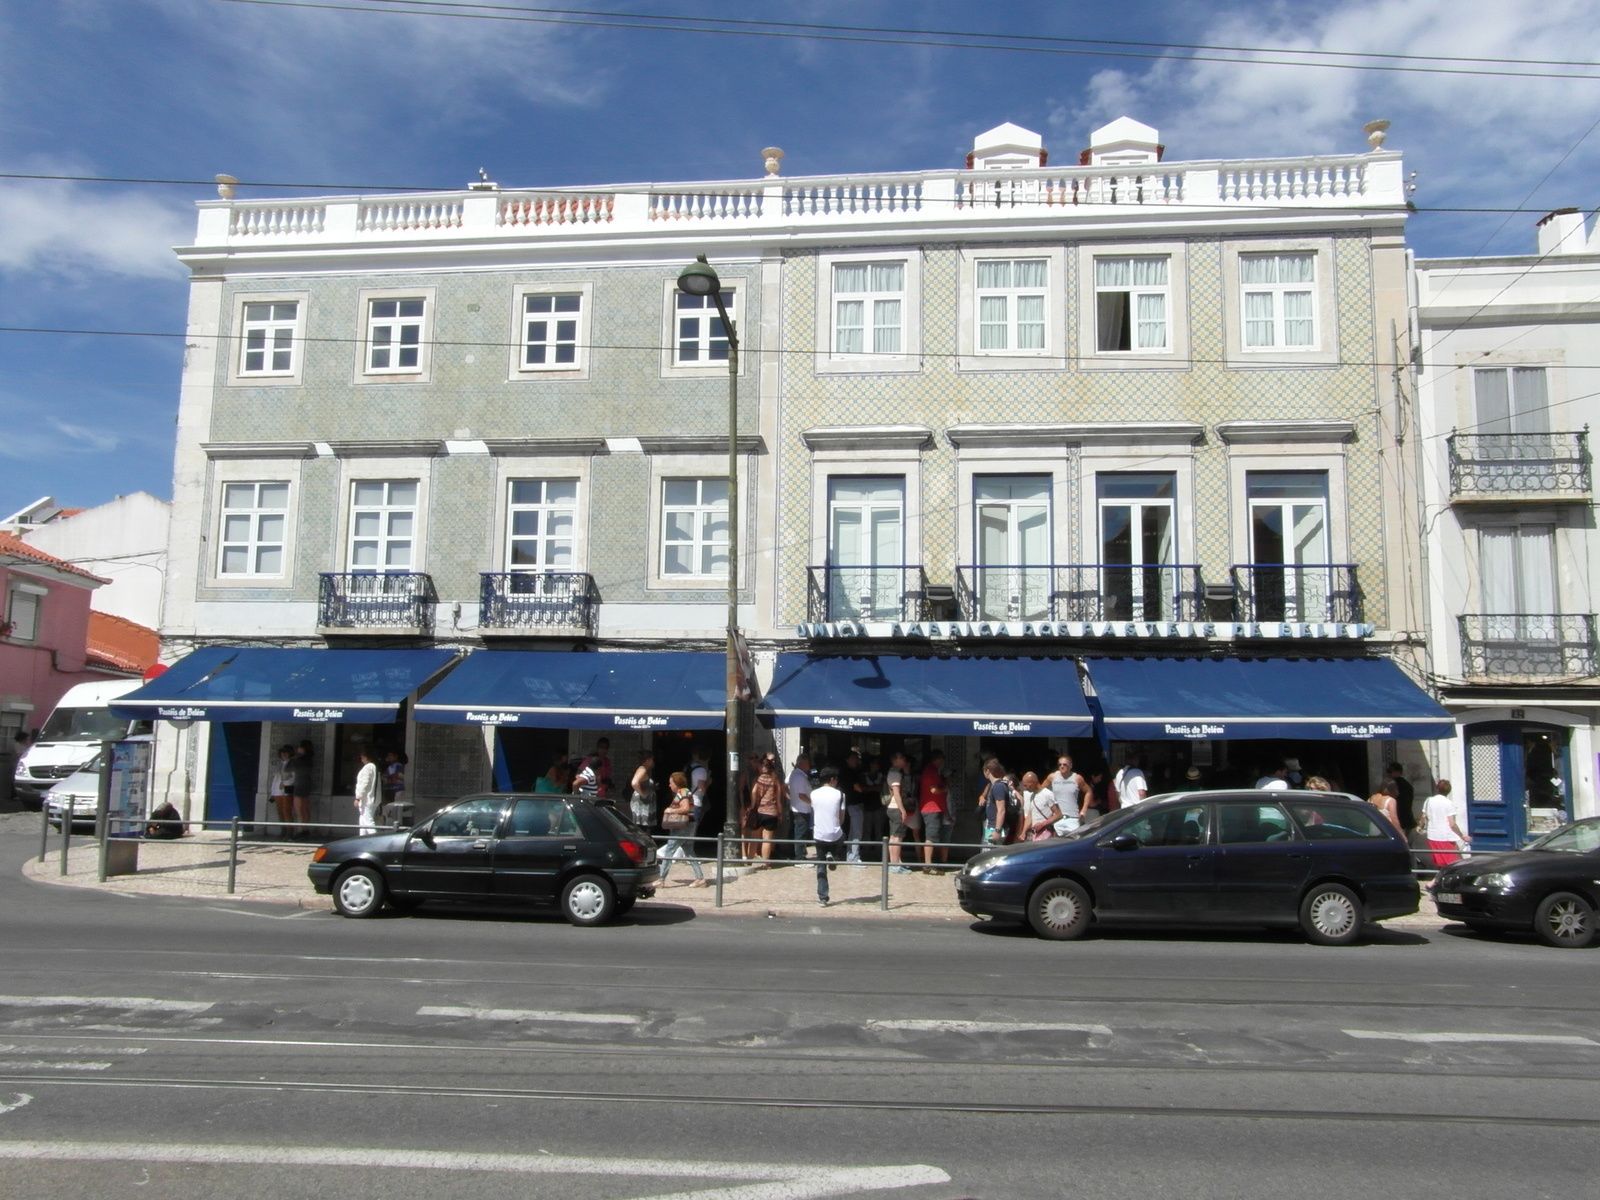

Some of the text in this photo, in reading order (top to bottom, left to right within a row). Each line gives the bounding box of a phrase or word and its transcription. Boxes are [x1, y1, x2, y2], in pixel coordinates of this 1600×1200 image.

[315, 710, 324, 718] de
[637, 717, 647, 725] de
[998, 722, 1008, 731] de
[1191, 725, 1201, 734] de
[1358, 725, 1368, 734] de
